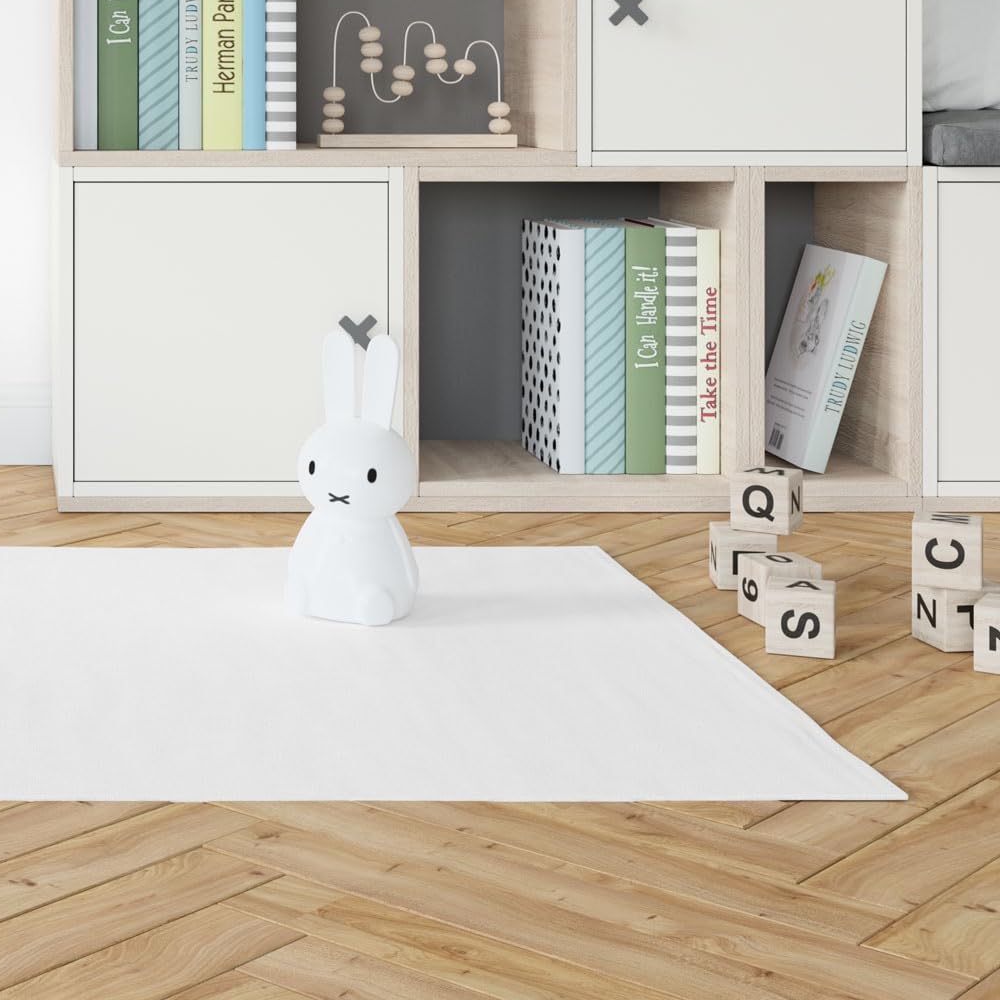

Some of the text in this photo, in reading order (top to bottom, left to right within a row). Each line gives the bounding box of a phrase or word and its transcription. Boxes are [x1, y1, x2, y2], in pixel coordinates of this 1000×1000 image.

[106, 36, 132, 45] I
[109, 9, 132, 34] Can
[185, 36, 199, 83] TRUDY
[212, 28, 236, 94] Herman
[631, 265, 659, 369] I Can Handle it!
[700, 286, 717, 423] Take the Time
[824, 320, 866, 415] TRUDY LUDWIG
[742, 485, 775, 522] Q
[925, 537, 965, 570] C
[780, 609, 821, 640] S
